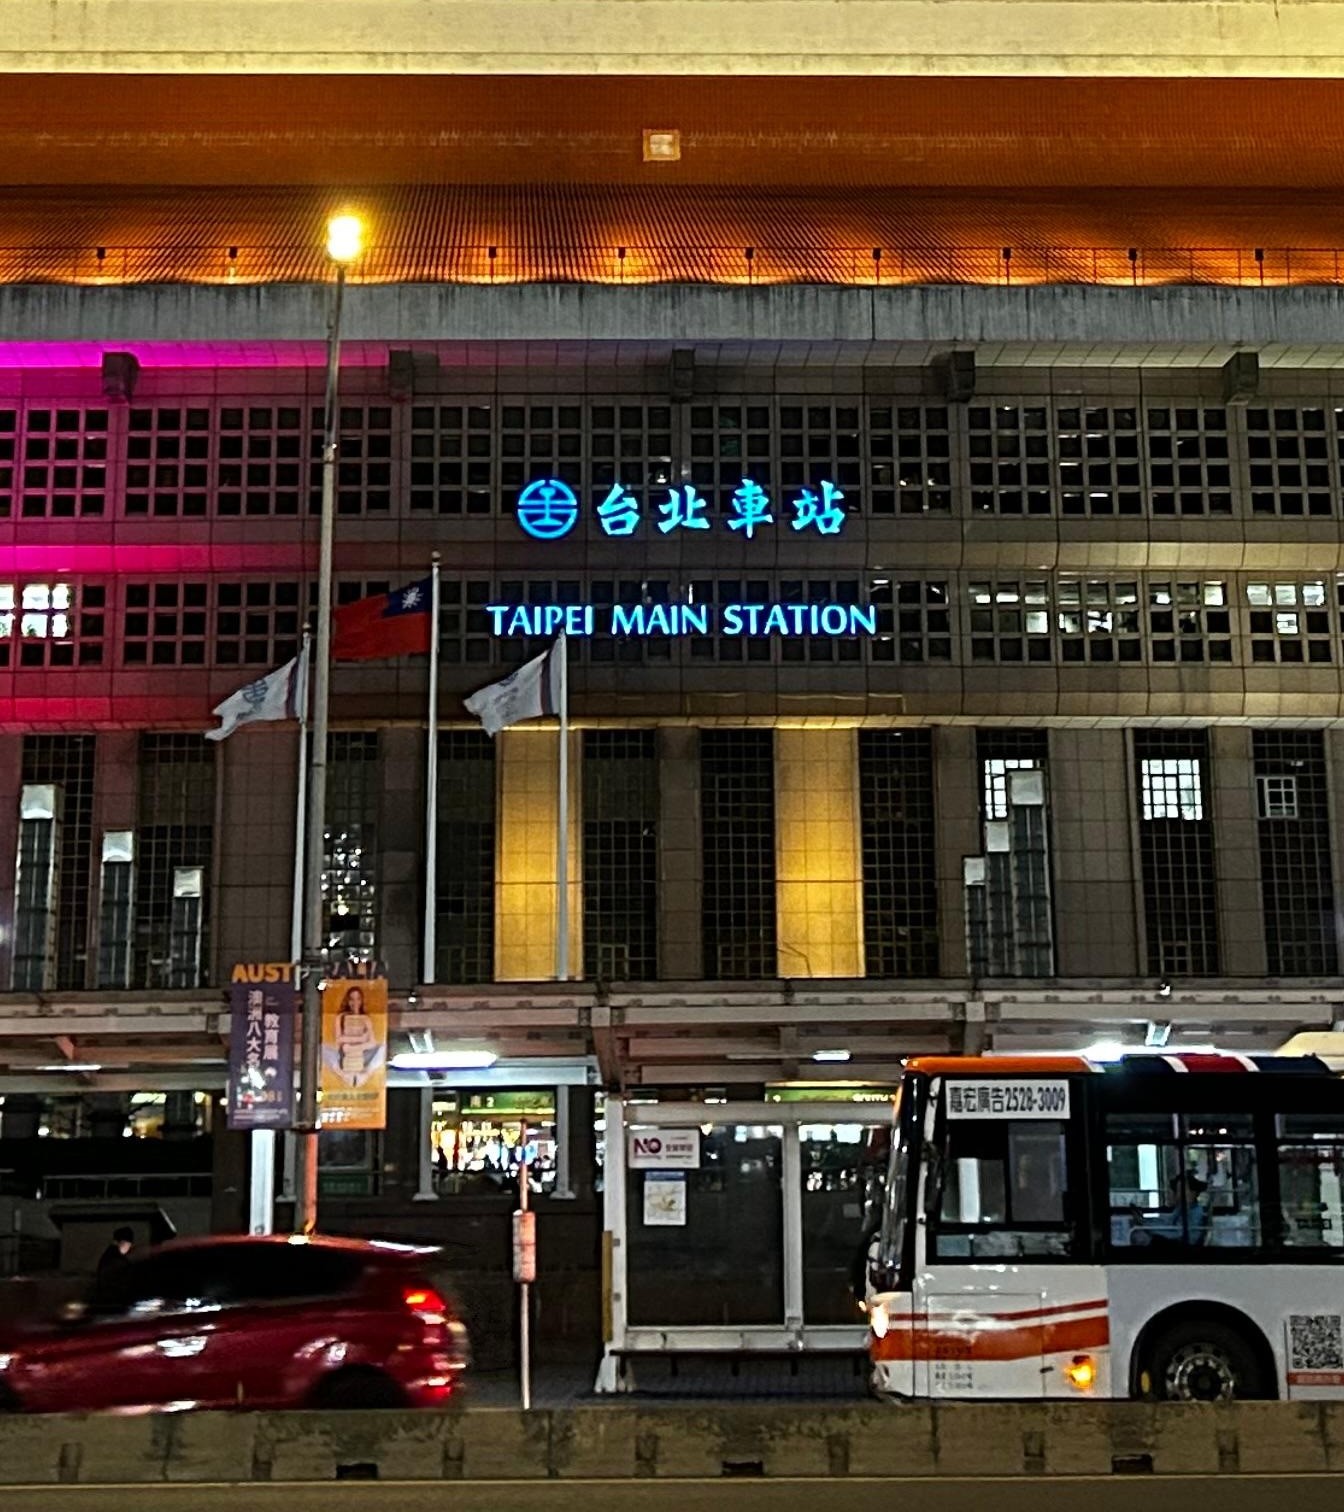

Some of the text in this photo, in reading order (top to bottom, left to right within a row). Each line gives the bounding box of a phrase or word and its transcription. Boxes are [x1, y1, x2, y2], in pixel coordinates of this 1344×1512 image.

[596, 478, 846, 538] 台北車站
[487, 603, 877, 636] TAIPEI MAIN STATION
[232, 963, 293, 983] AUST
[634, 1137, 662, 1154] NO
